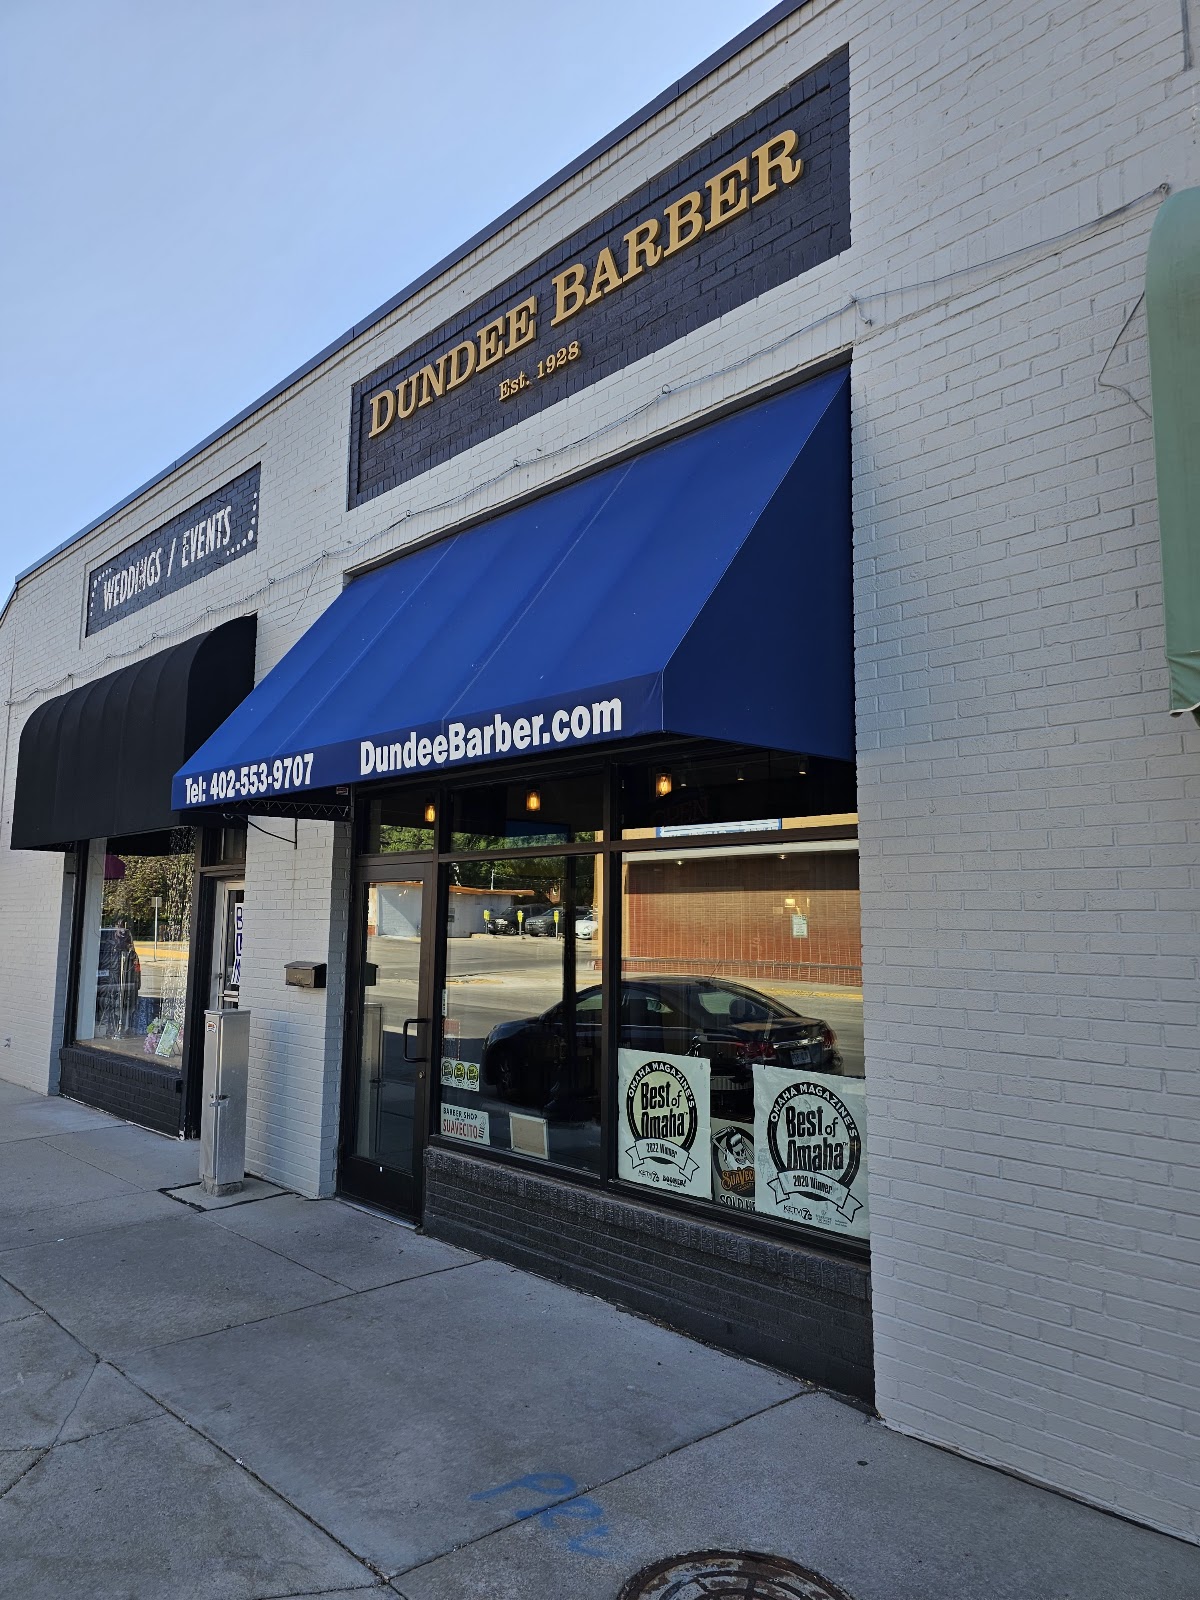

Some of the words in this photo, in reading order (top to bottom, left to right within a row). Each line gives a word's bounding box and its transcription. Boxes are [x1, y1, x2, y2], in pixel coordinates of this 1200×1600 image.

[368, 296, 539, 438] DUNDEE
[550, 129, 803, 328] BARBER
[498, 372, 530, 402] Est.
[537, 341, 582, 379] 1928
[102, 547, 162, 611] WEDDINGS
[181, 505, 233, 567] EVENTS
[359, 697, 623, 776] DundeeBarber.com
[185, 778, 206, 805] Tel:
[210, 753, 314, 800] 402-553-9707
[628, 1063, 652, 1098] OMAHA
[652, 1061, 695, 1109] MAGAZINE'S
[641, 1081, 670, 1111] Best
[671, 1090, 682, 1108] of
[443, 1107, 462, 1118] BARBER
[463, 1111, 478, 1121] SHOP
[640, 1110, 685, 1139] Omaha
[770, 1087, 798, 1122] OMAHA
[800, 1084, 858, 1137] MAGAZINE'S
[785, 1106, 823, 1138] Best
[825, 1117, 839, 1136] of
[442, 1118, 478, 1139] SUAVECITO
[646, 1143, 659, 1155] 2022
[659, 1142, 678, 1159] Winner
[787, 1138, 844, 1171] Omaha
[793, 1175, 809, 1188] 2020
[810, 1178, 833, 1195] Winner
